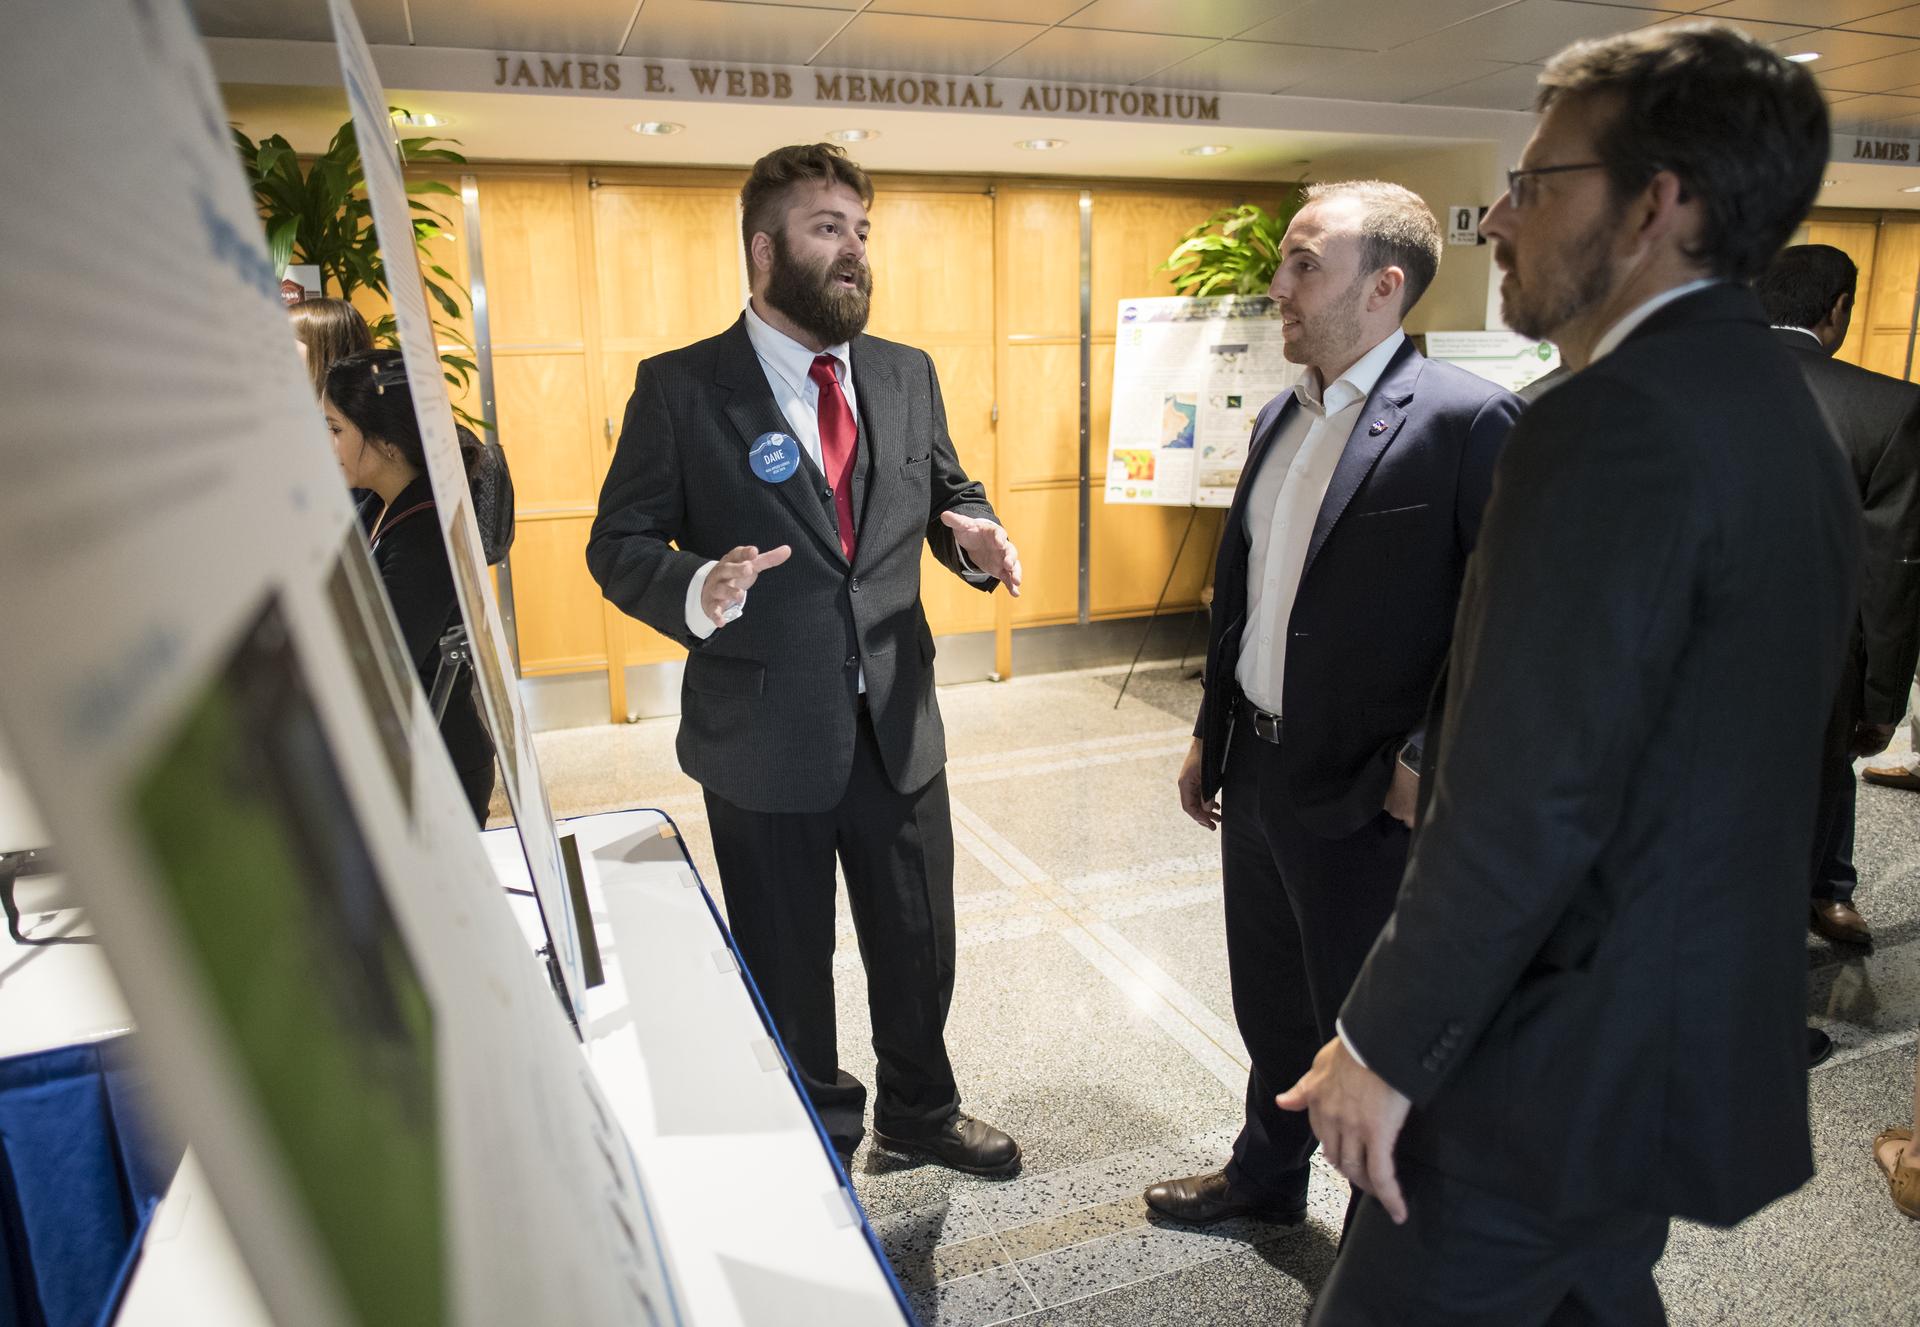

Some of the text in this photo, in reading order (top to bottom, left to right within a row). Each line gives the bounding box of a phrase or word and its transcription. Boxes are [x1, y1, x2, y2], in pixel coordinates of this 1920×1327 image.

[494, 57, 1221, 121] JAMES E. WEBB MEMORIAL AUDITORIUM
[1853, 139, 1910, 162] JAMES
[763, 449, 785, 465] DANE
